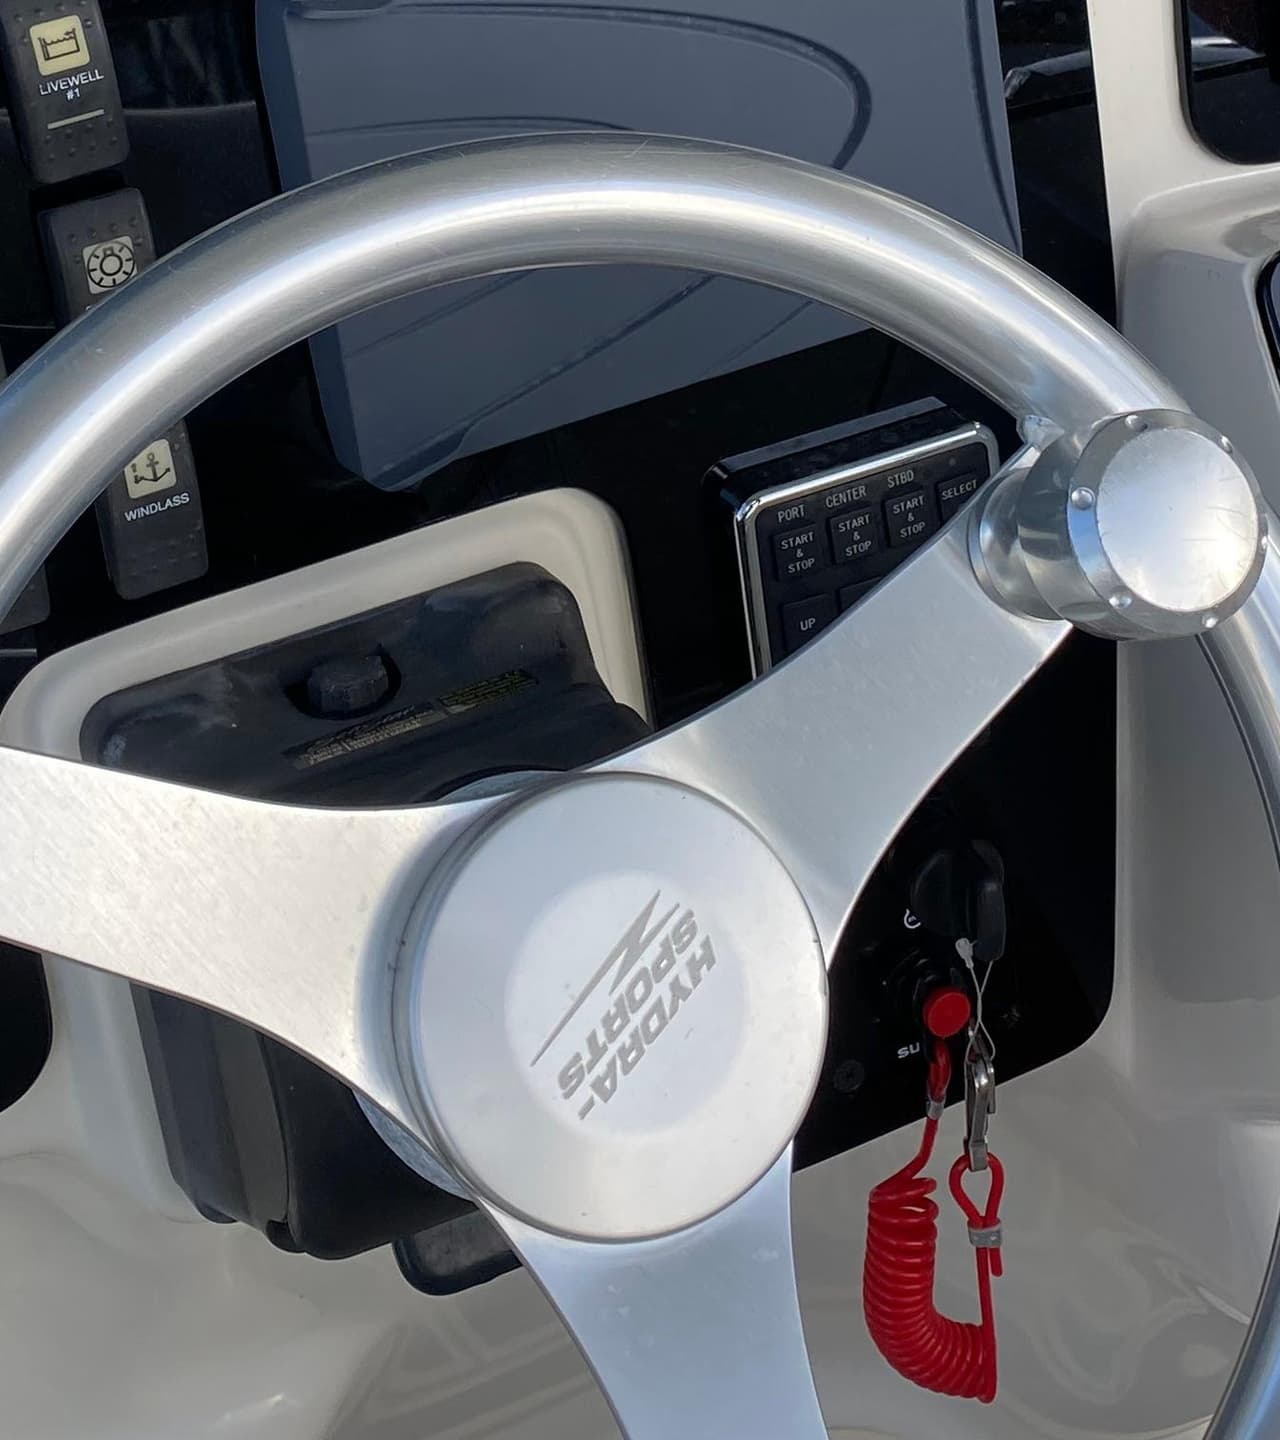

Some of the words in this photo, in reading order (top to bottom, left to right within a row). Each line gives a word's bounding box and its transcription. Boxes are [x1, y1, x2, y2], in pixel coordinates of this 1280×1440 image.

[38, 68, 105, 96] LIVEWELL
[65, 87, 82, 101] #1
[778, 505, 805, 522] PORT
[826, 486, 867, 508] CENTER
[888, 470, 913, 488] STBD
[942, 480, 977, 500] SELECT
[124, 493, 190, 521] WINDLASS
[893, 496, 924, 513] START
[839, 514, 870, 532] START
[900, 522, 925, 538] STOP
[781, 532, 814, 549] START
[846, 541, 871, 556] STOP
[788, 558, 814, 573] STOP
[800, 617, 816, 632] UP
[558, 909, 698, 1100] SPORTS
[578, 934, 716, 1120] HYDRA-
